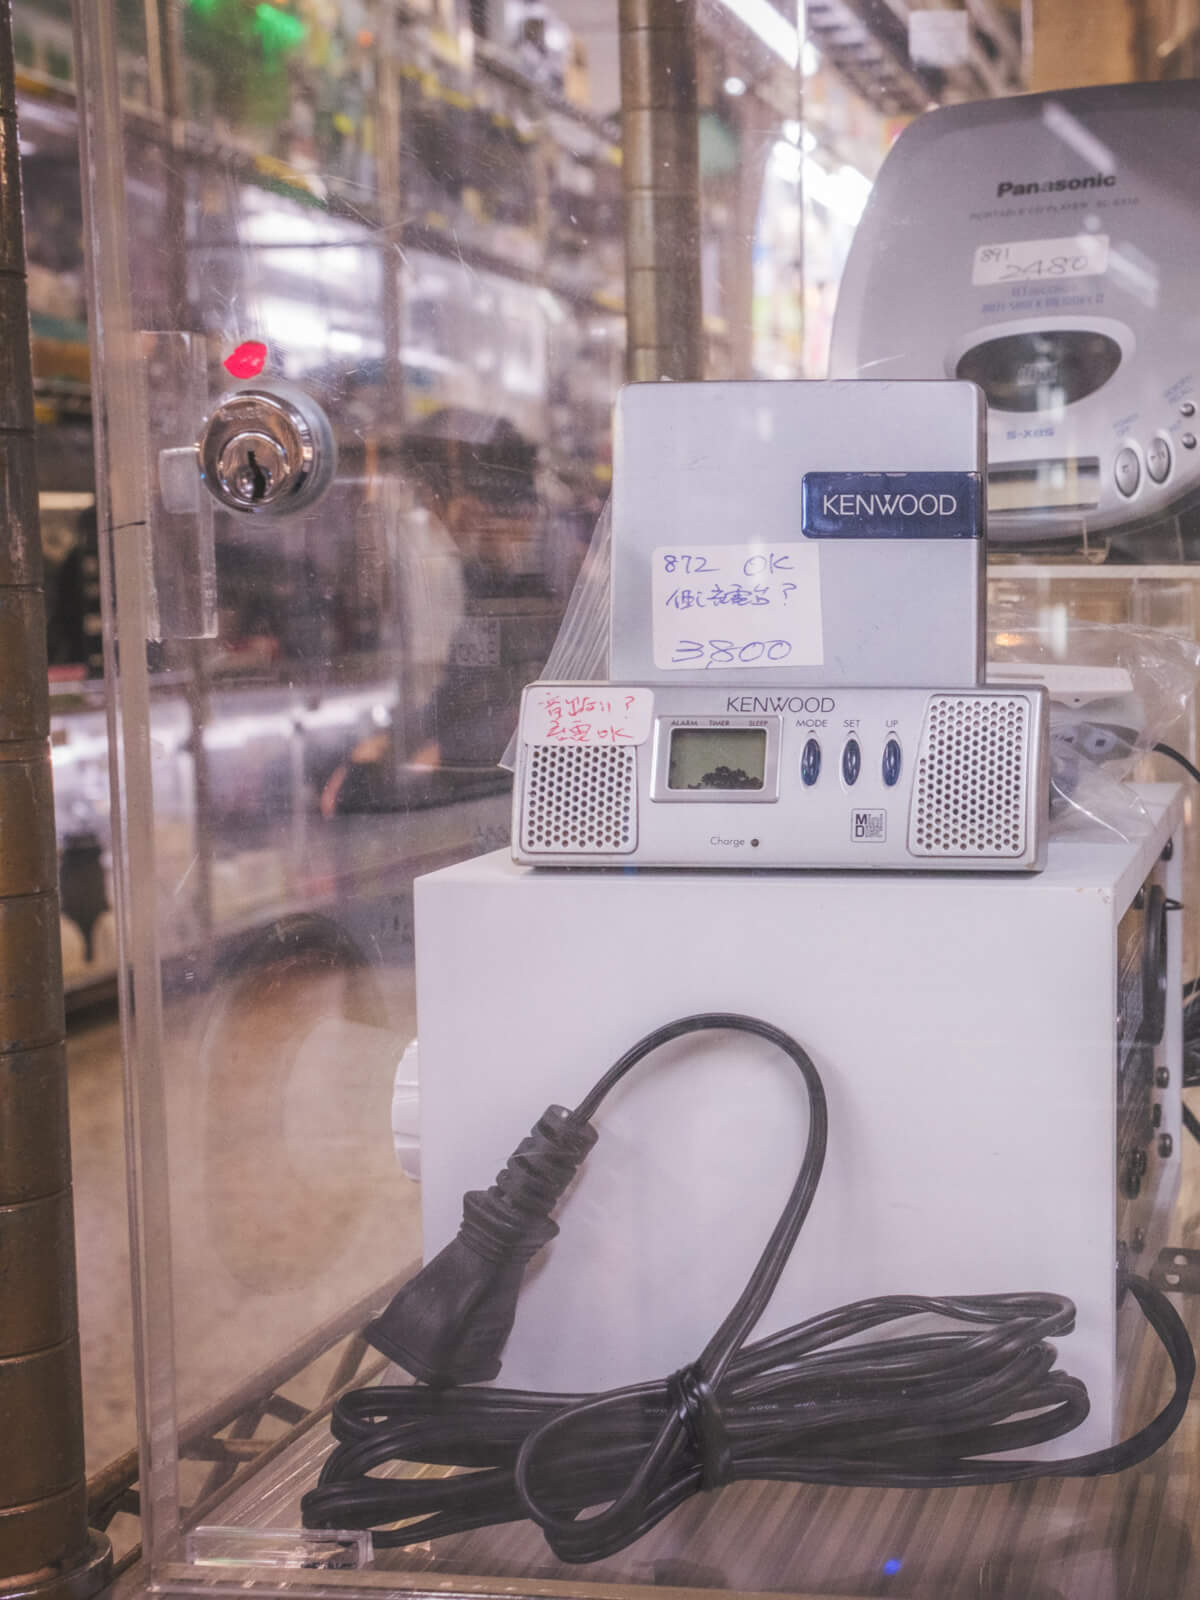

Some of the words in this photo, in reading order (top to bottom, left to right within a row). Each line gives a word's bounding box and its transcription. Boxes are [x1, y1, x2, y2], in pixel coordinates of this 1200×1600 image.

[997, 173, 1117, 198] Panasonic
[980, 248, 1010, 262] 891
[822, 493, 958, 517] KENWOOD
[663, 554, 721, 574] 872
[744, 553, 794, 576] OK
[726, 697, 835, 713] KENWOOD
[671, 719, 698, 727] ALARM
[708, 719, 730, 727] TIMER
[748, 719, 768, 727] SLEEP
[795, 719, 828, 728] MODE
[843, 719, 861, 728] SET
[885, 719, 899, 728] UP
[709, 836, 746, 849] Charge
